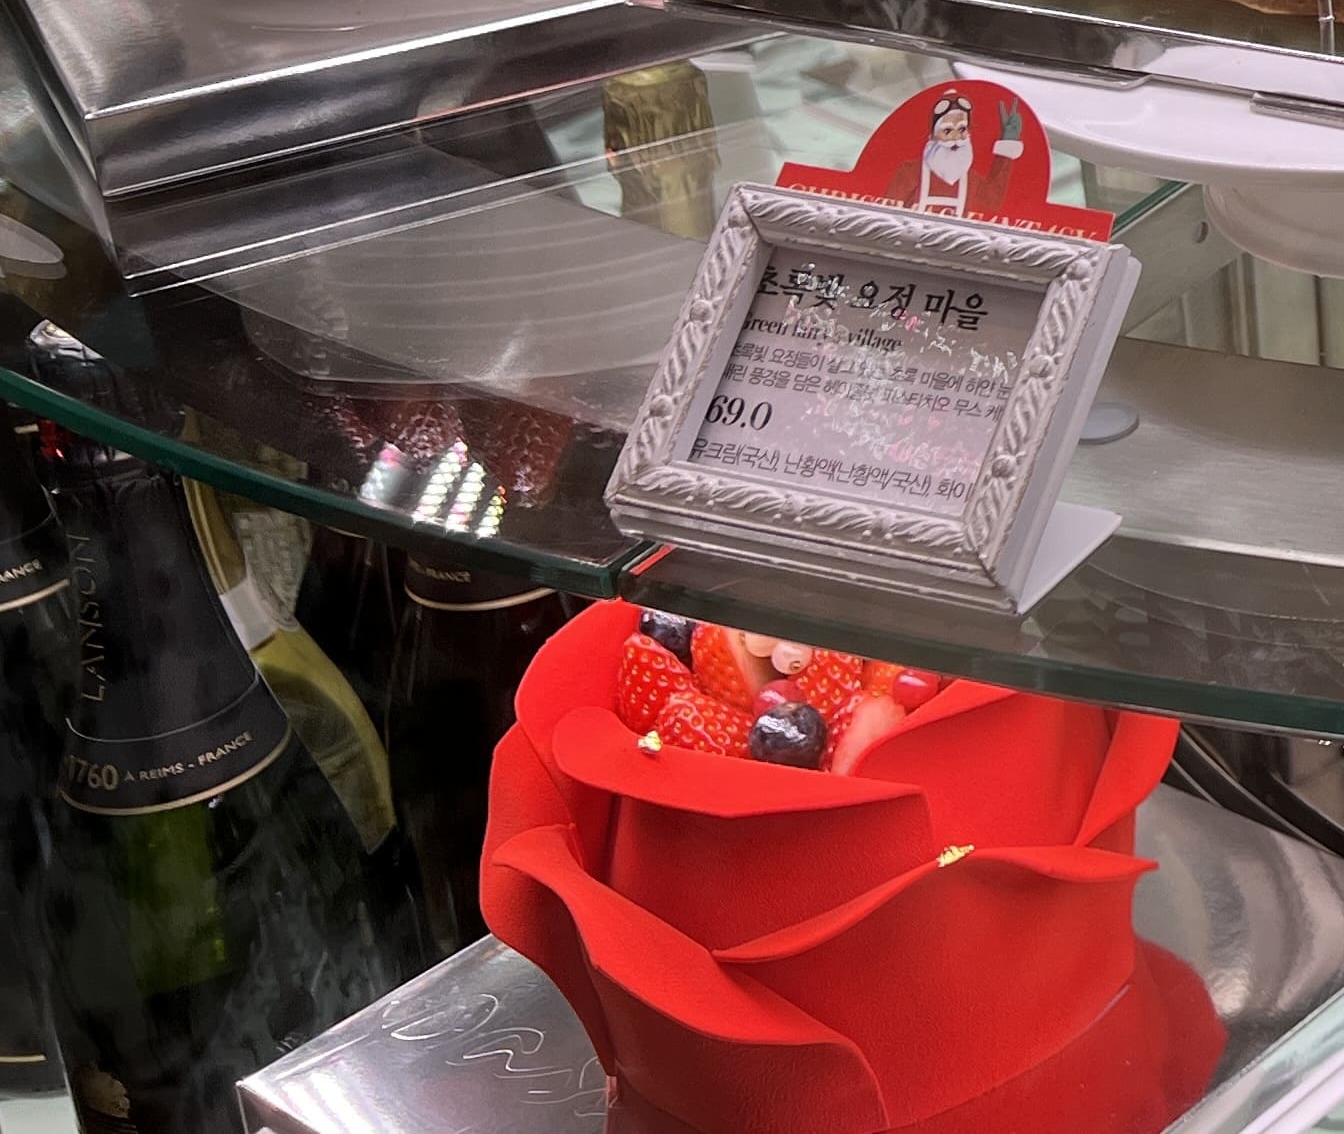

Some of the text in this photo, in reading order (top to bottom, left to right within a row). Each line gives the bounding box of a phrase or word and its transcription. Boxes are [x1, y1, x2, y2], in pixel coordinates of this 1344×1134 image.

[850, 280, 917, 321] 요정
[925, 289, 989, 331] 마을
[847, 325, 903, 353] village
[748, 366, 792, 389] 풍경을
[792, 373, 823, 394] 담은
[952, 396, 986, 417] 무스
[771, 347, 827, 372] 요정들이
[920, 369, 965, 393] 마을에
[965, 376, 996, 397] 하얀
[704, 395, 773, 431] 69.0
[66, 532, 106, 702] LANSON
[139, 762, 186, 782] REIMS
[198, 730, 254, 766] FRANCE
